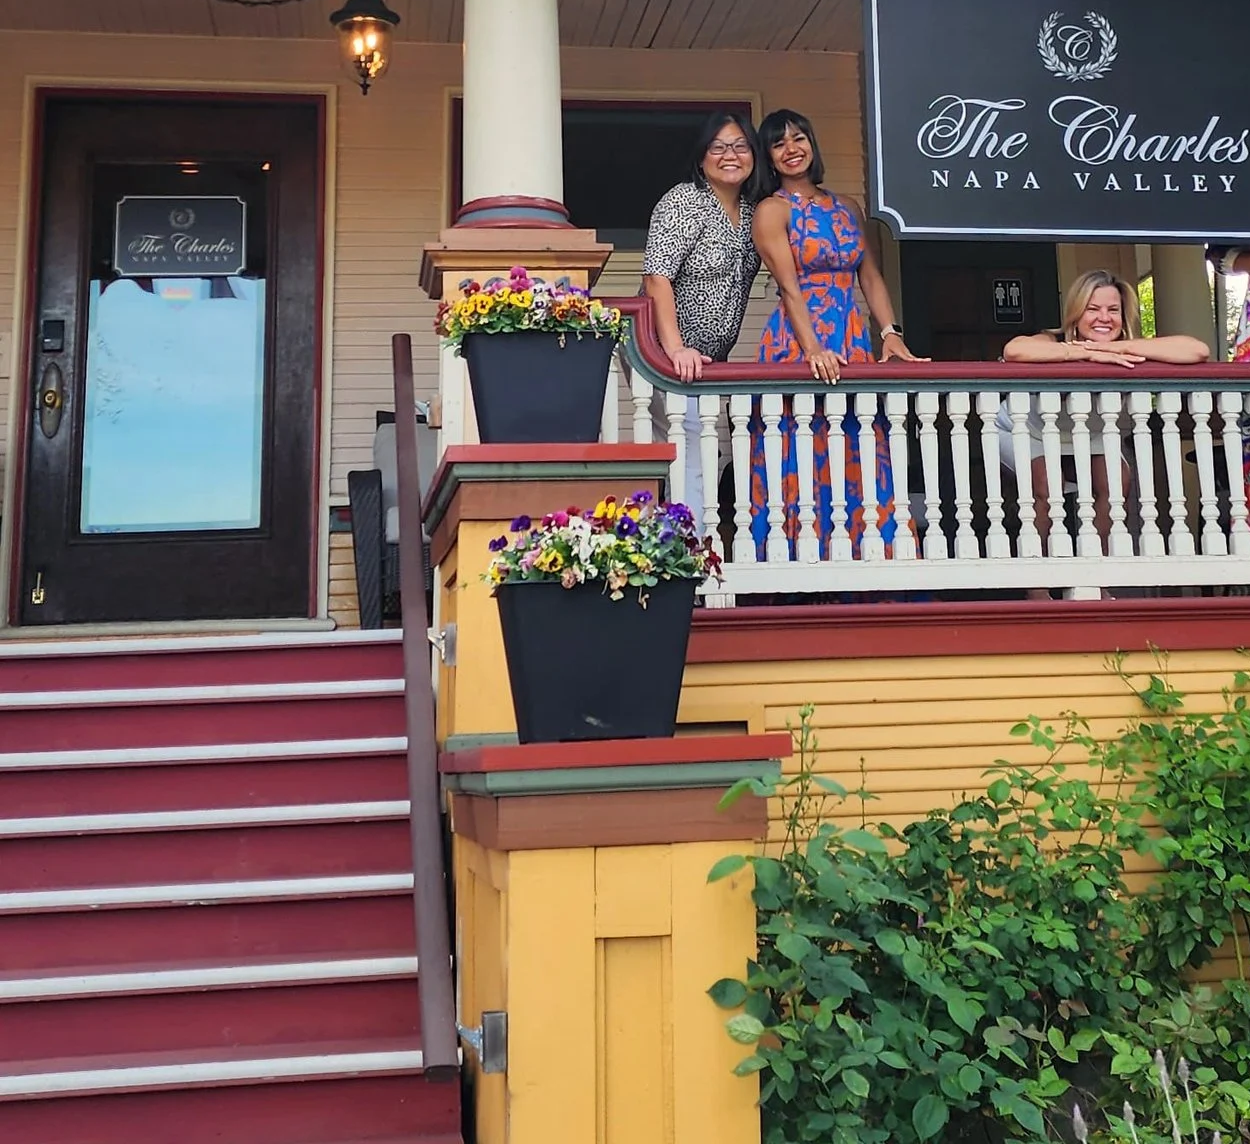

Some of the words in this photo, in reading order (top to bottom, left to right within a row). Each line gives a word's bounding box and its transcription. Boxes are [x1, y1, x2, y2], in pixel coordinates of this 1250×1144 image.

[917, 94, 1029, 159] The
[1048, 95, 1250, 166] Charles
[931, 169, 1040, 189] NAPA
[1073, 172, 1237, 193] VALLEY
[128, 234, 165, 254] The
[169, 233, 235, 255] Charles
